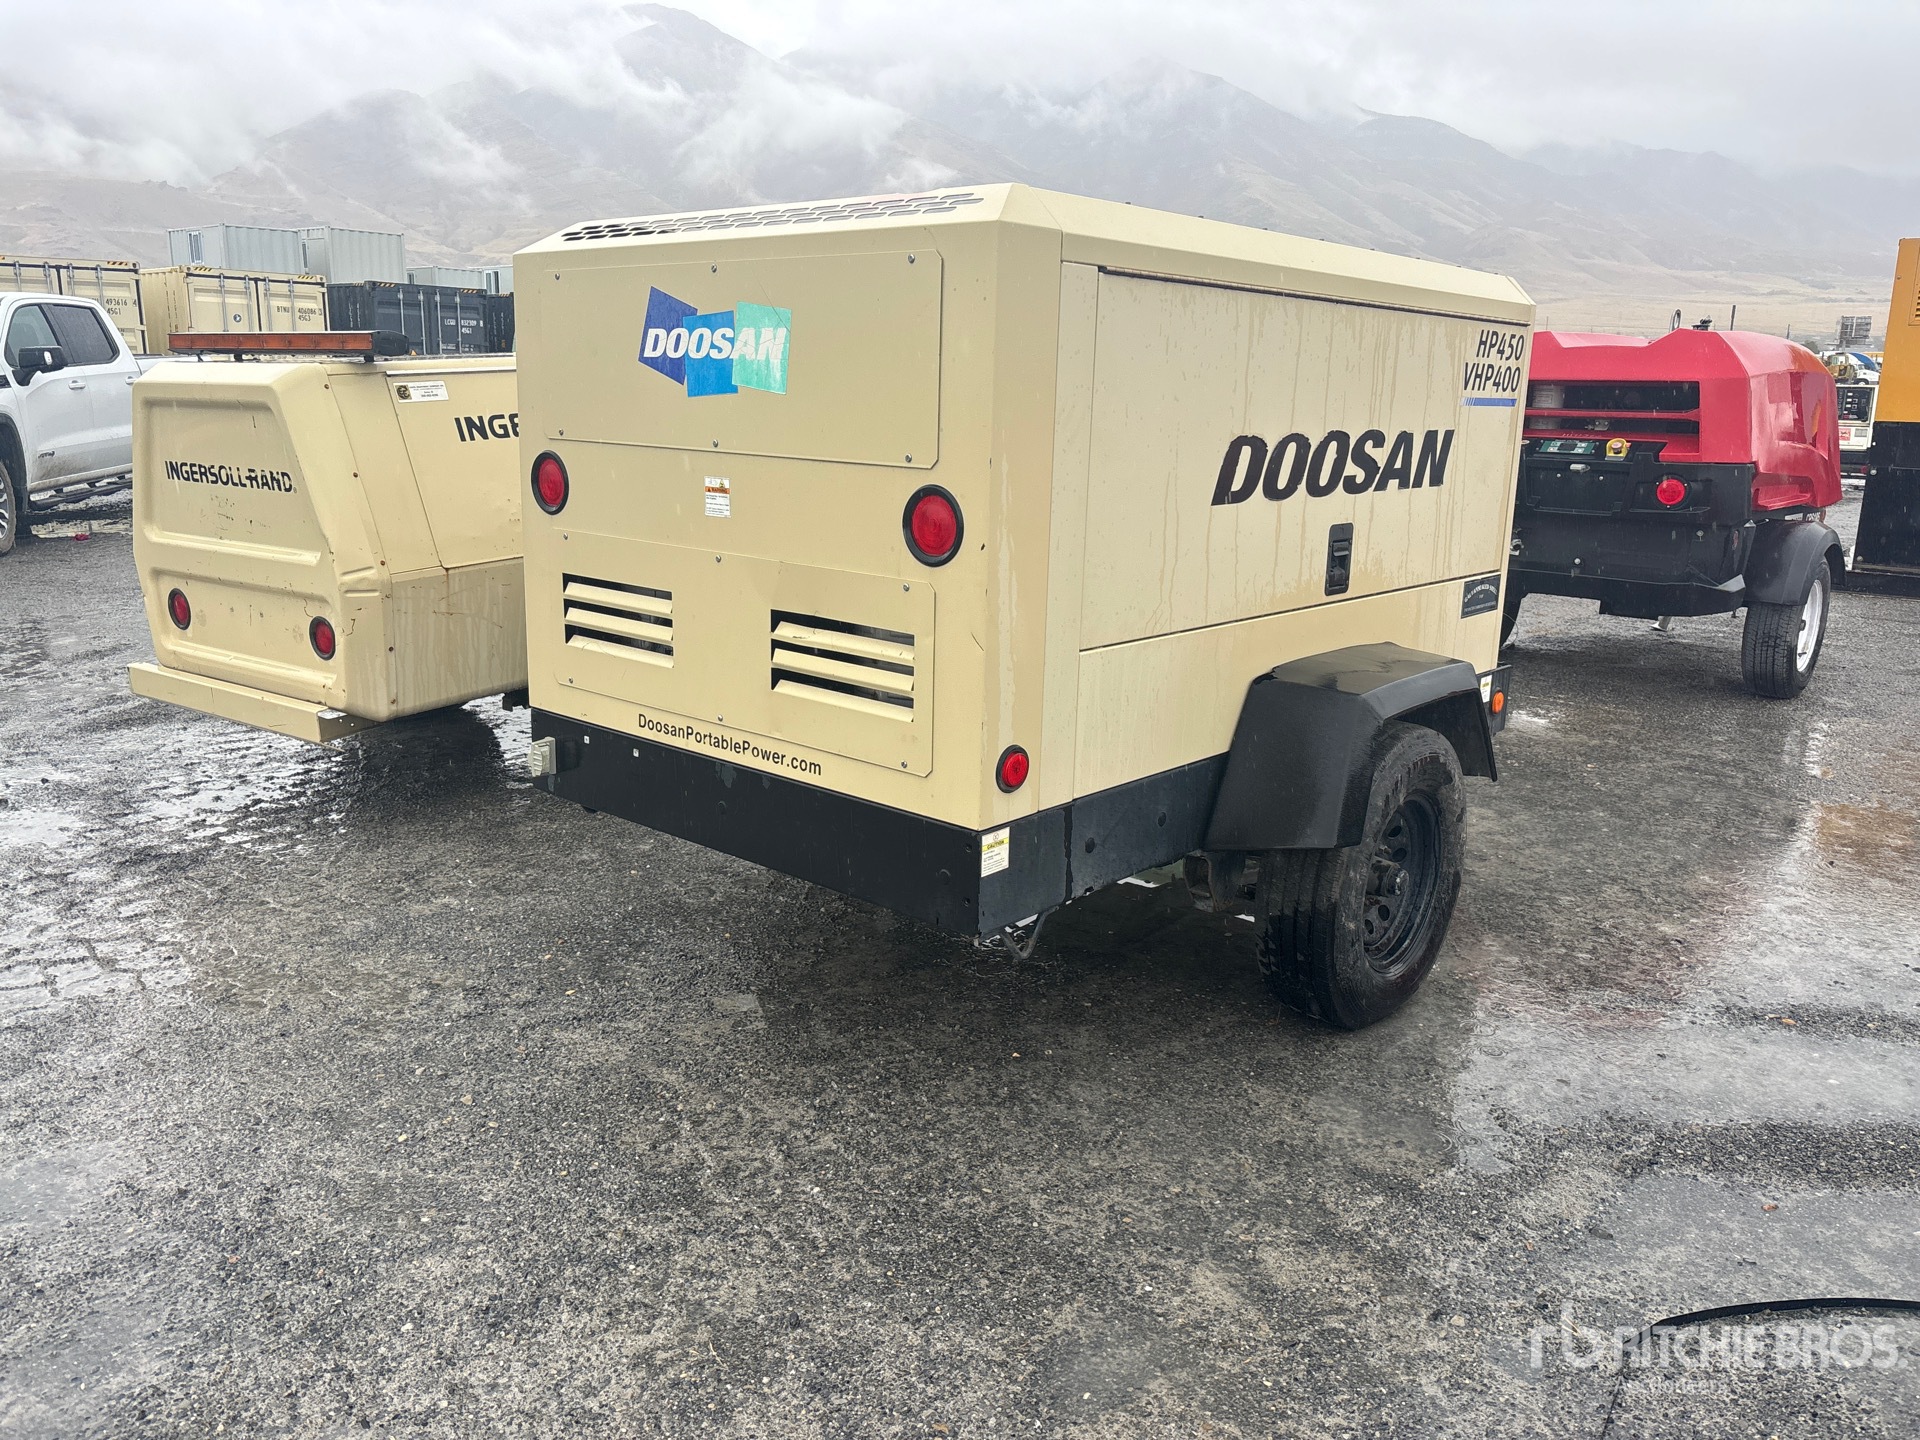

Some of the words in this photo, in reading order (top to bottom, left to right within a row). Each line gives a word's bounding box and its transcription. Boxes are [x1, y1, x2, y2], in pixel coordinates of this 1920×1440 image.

[643, 325, 788, 362] DOOSAN
[1475, 328, 1525, 362] HP450
[1463, 362, 1521, 393] VHP400
[164, 459, 295, 494] INGERSOLL-RAND
[1211, 428, 1455, 506] DOOSAN
[637, 712, 823, 777] DoosanPortablePower.com
